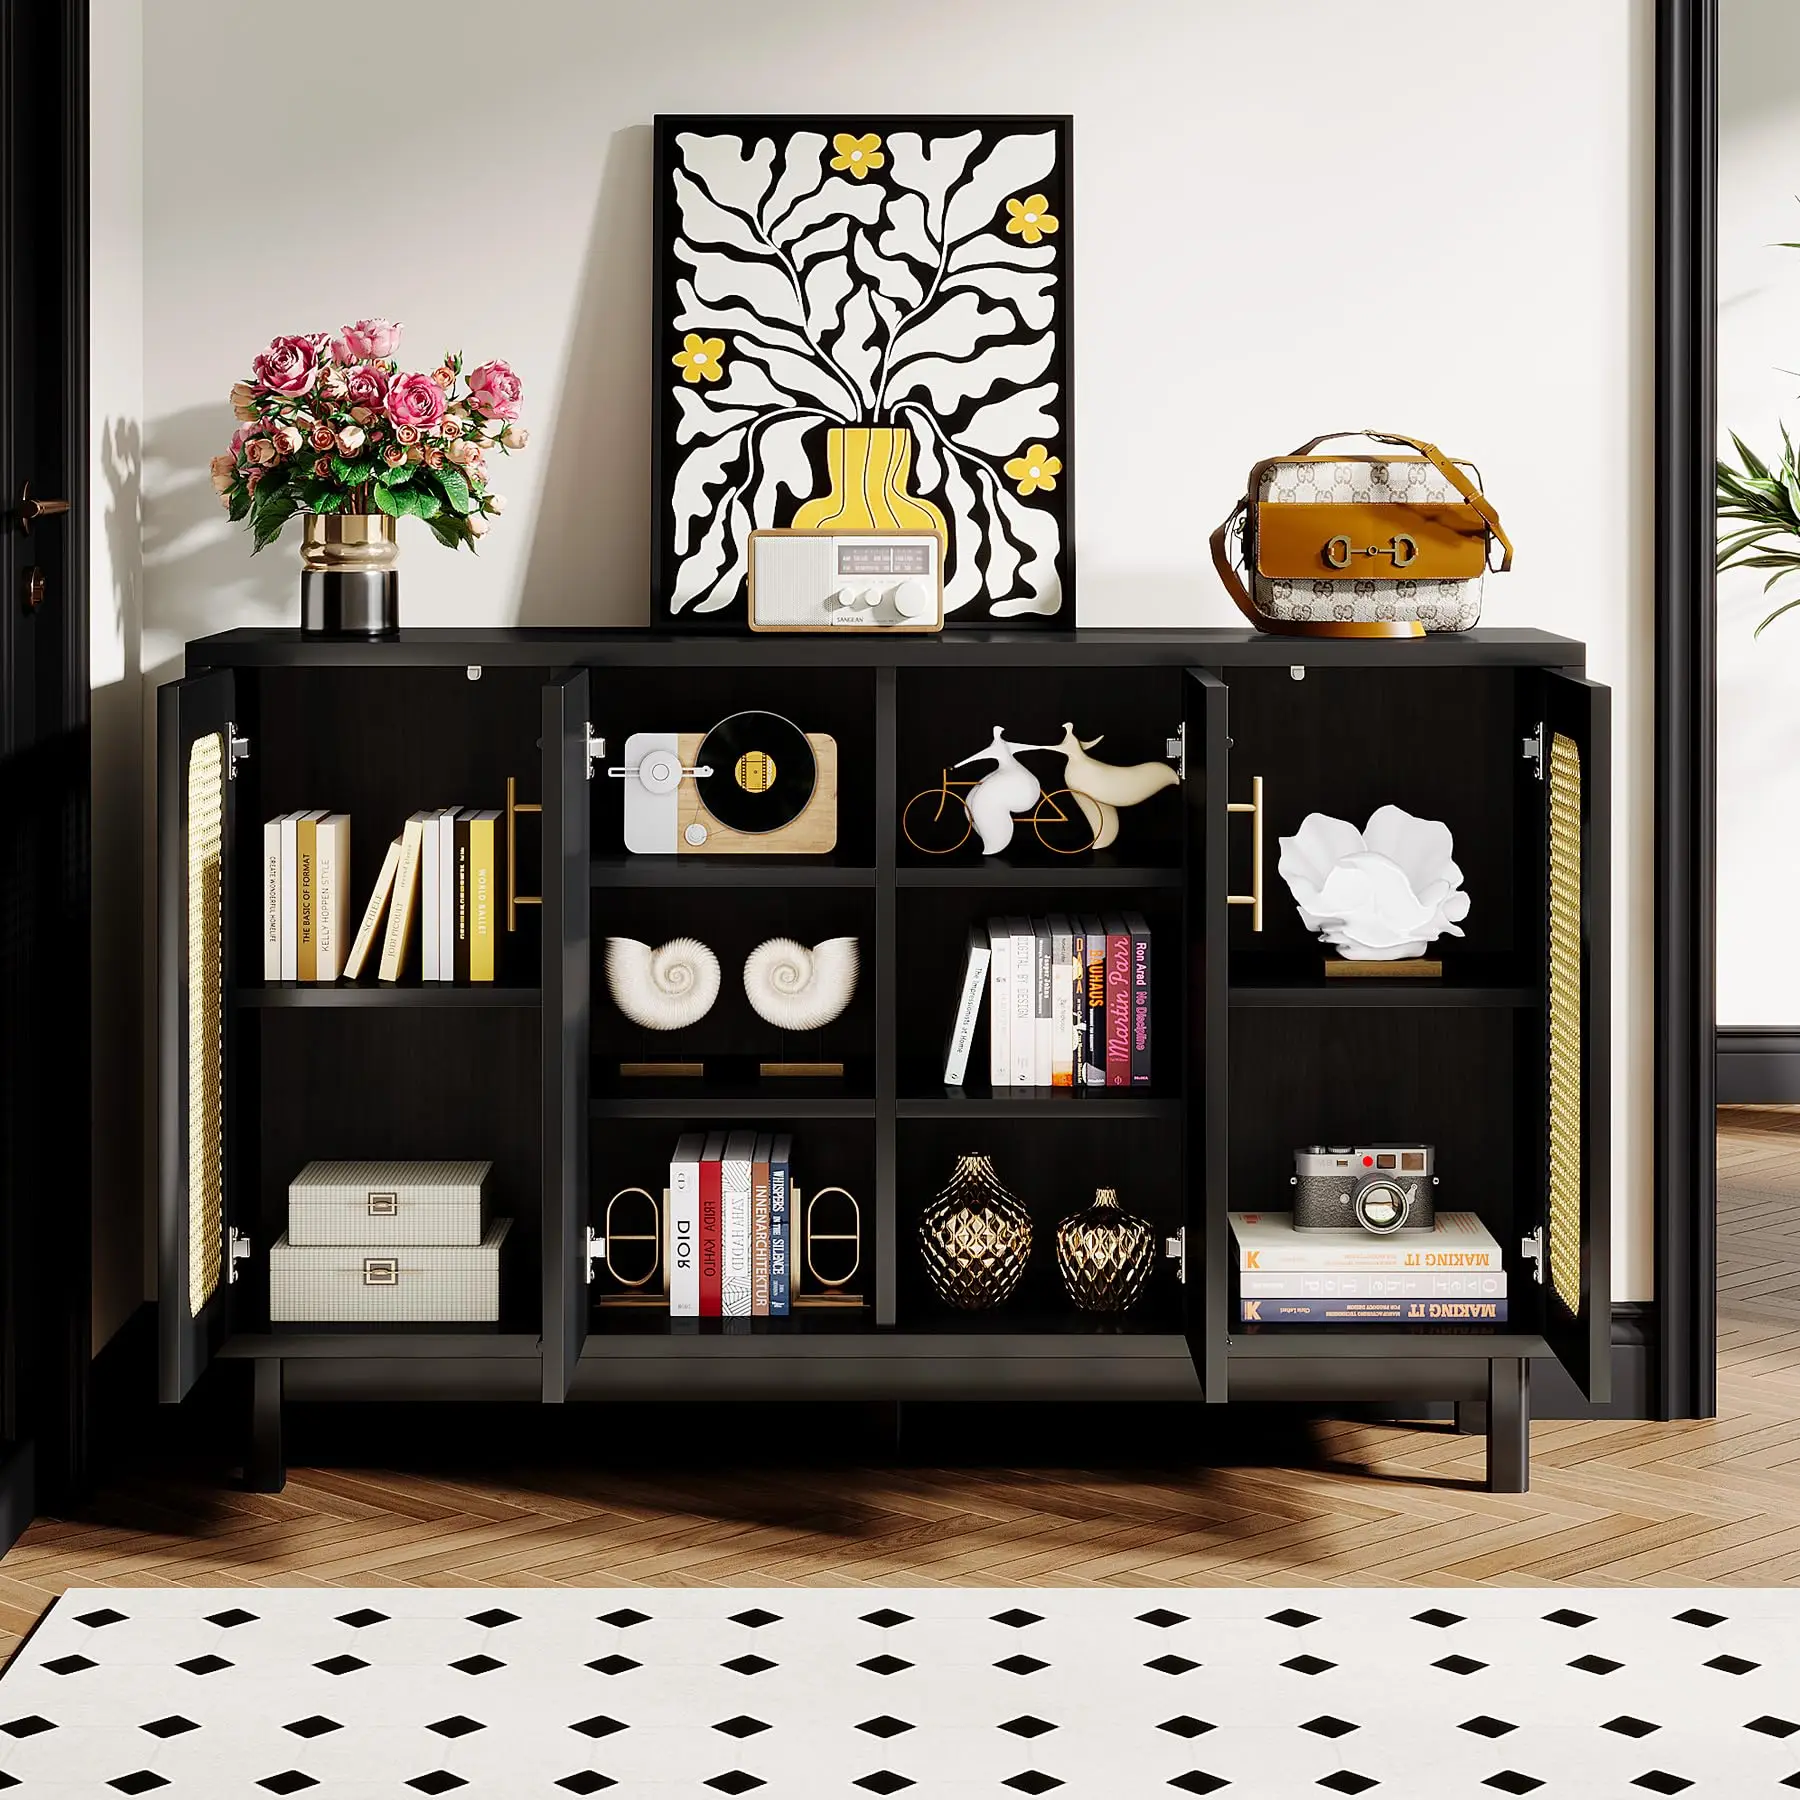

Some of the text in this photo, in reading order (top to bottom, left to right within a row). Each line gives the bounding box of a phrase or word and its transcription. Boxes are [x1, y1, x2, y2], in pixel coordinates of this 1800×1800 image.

[269, 856, 277, 878] CREATE
[302, 853, 311, 944] THE BASIC OF FORMAT
[321, 859, 330, 952] KELLY HOPPEN STYLE
[478, 868, 487, 935] WORLD BALLET
[1017, 936, 1029, 1019] DIGITAL BY DESIGN
[1089, 950, 1104, 1007] BAUHAUS
[1108, 937, 1129, 985] Parr
[1134, 942, 1148, 1051] Ron Arad No Discipline
[957, 1035, 967, 1053] Home
[1108, 990, 1129, 1058] Martin
[772, 1170, 785, 1212] WHISPERS
[755, 1185, 768, 1306] INNENARCHITEKTUR
[772, 1224, 780, 1235] THE
[772, 1238, 785, 1275] SILENCE
[1404, 1253, 1421, 1266] IT
[1425, 1253, 1490, 1266] MAKING
[1408, 1303, 1497, 1318] MAKING IT
